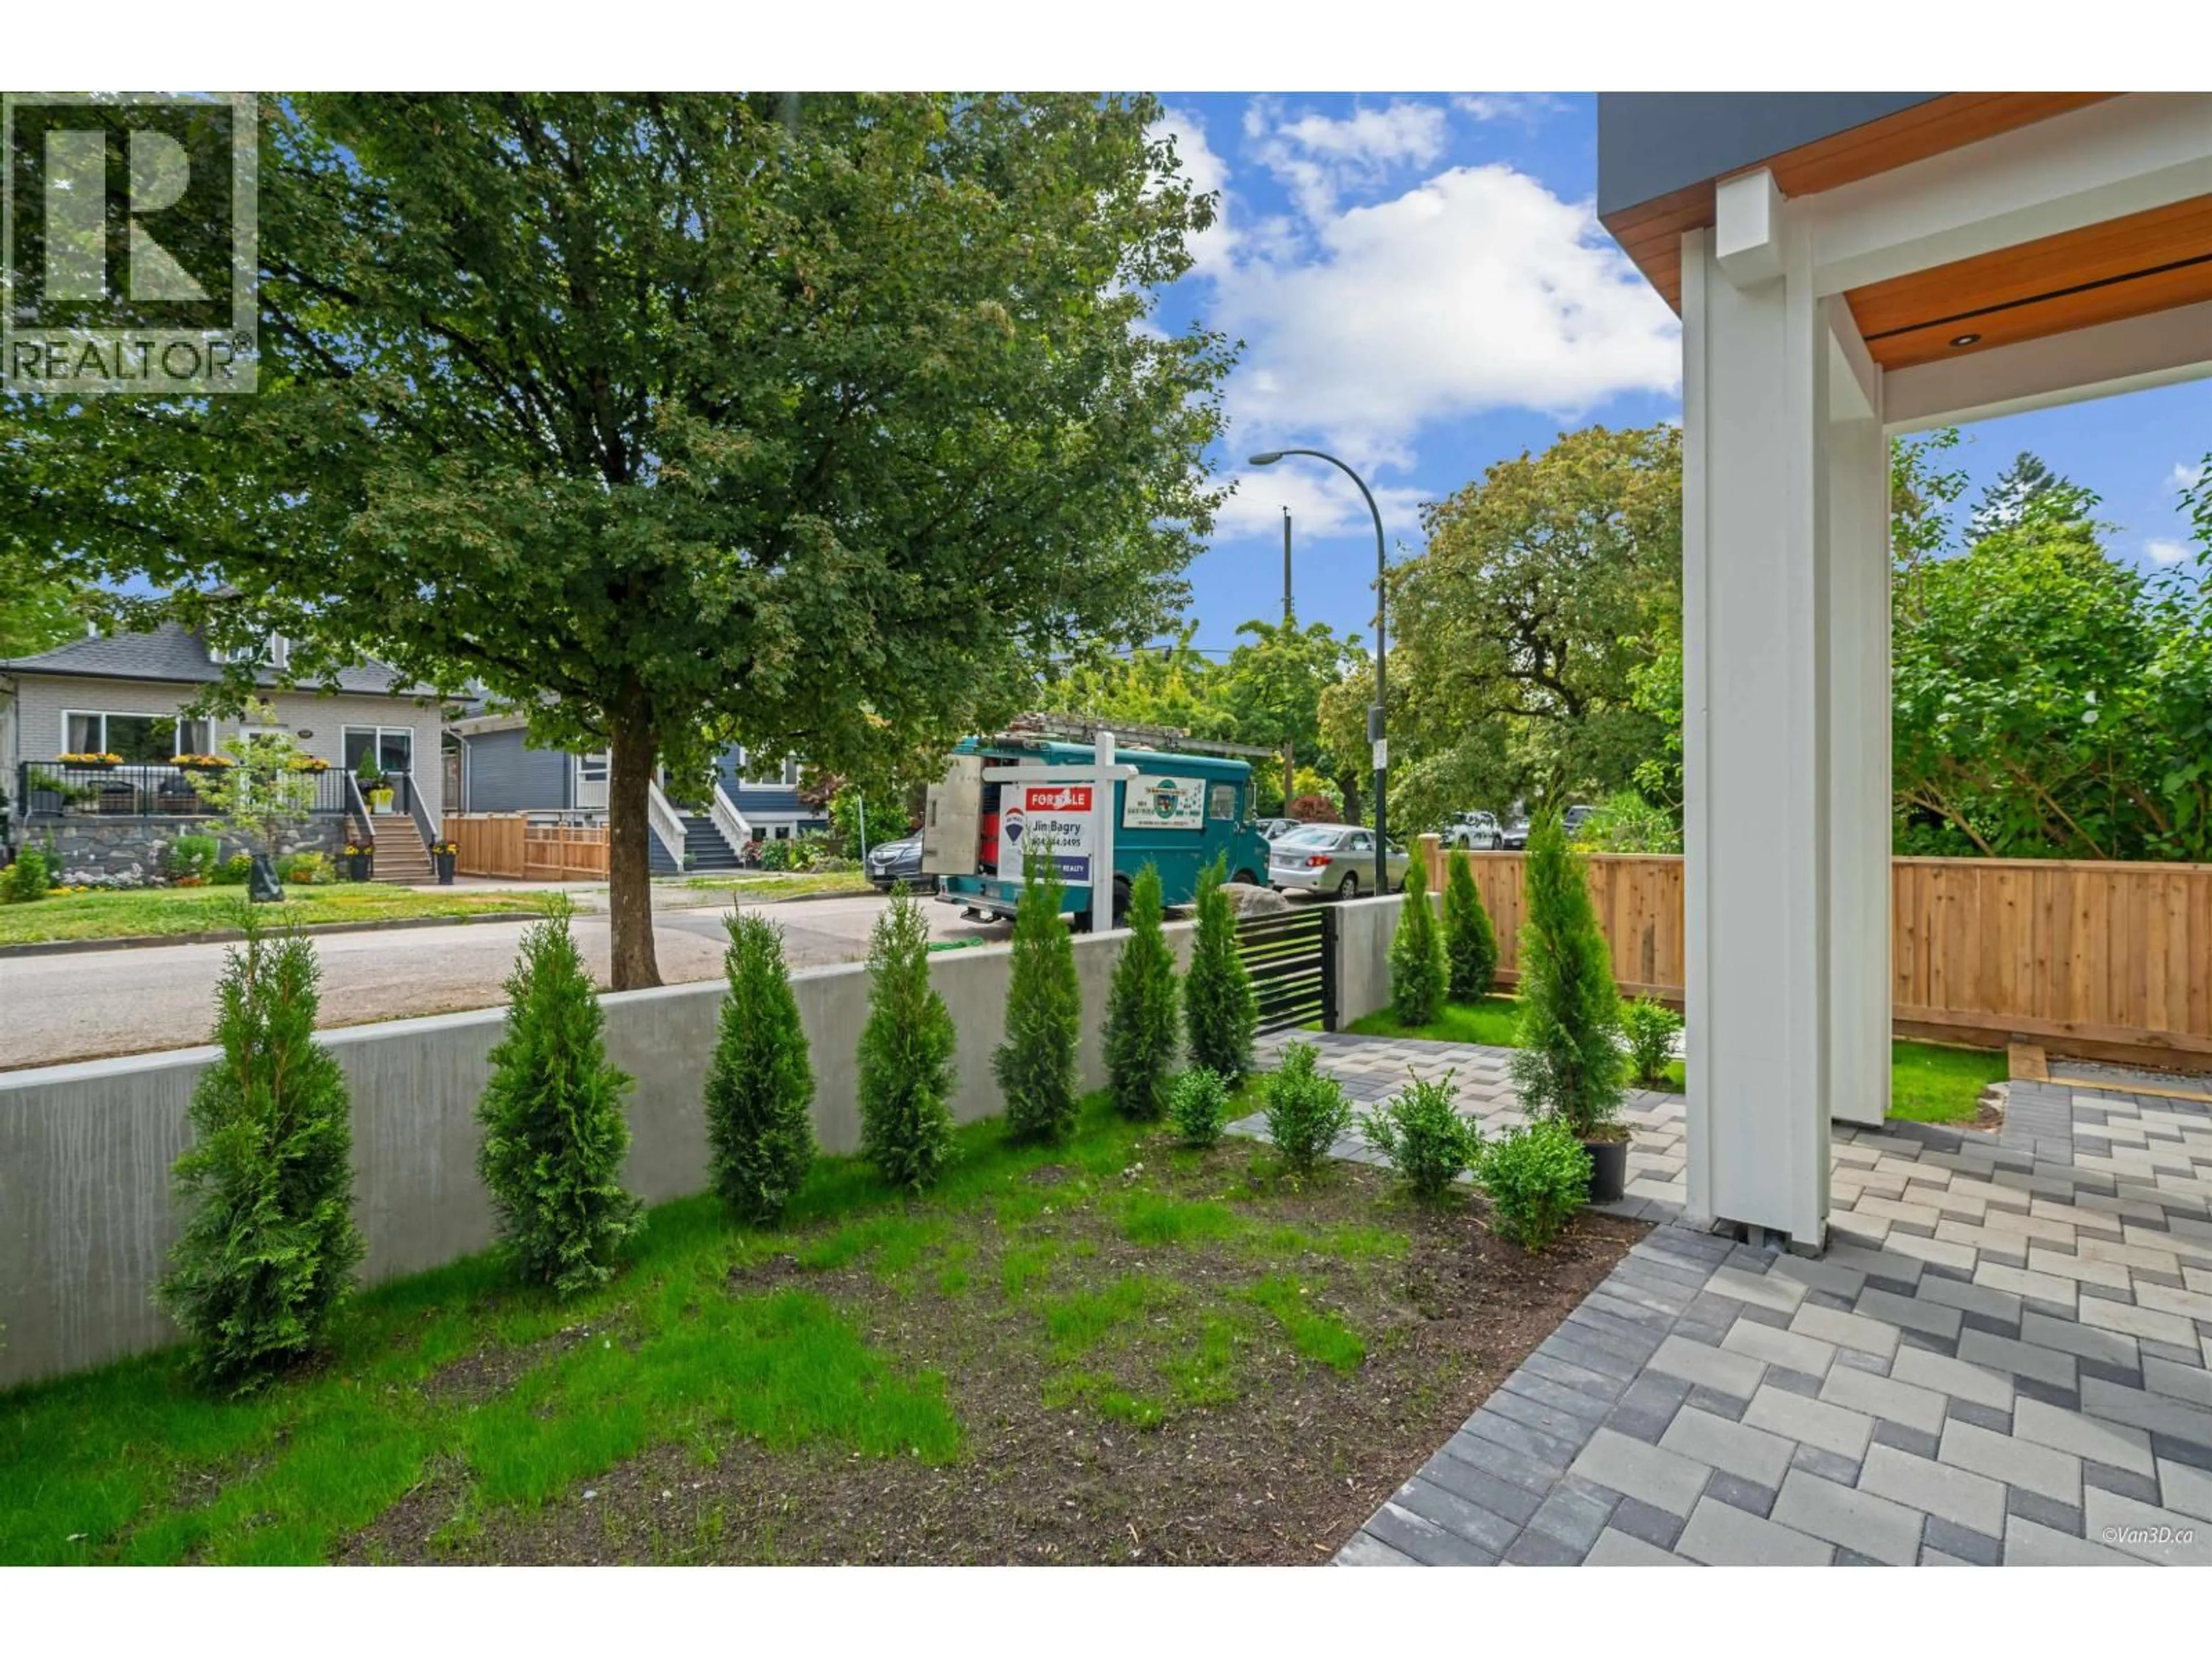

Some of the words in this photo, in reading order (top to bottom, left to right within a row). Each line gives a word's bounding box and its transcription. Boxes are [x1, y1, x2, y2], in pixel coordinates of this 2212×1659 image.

[1032, 794, 1053, 806] FOR
[1055, 794, 1085, 805] LE
[1051, 820, 1081, 835] Bagry
